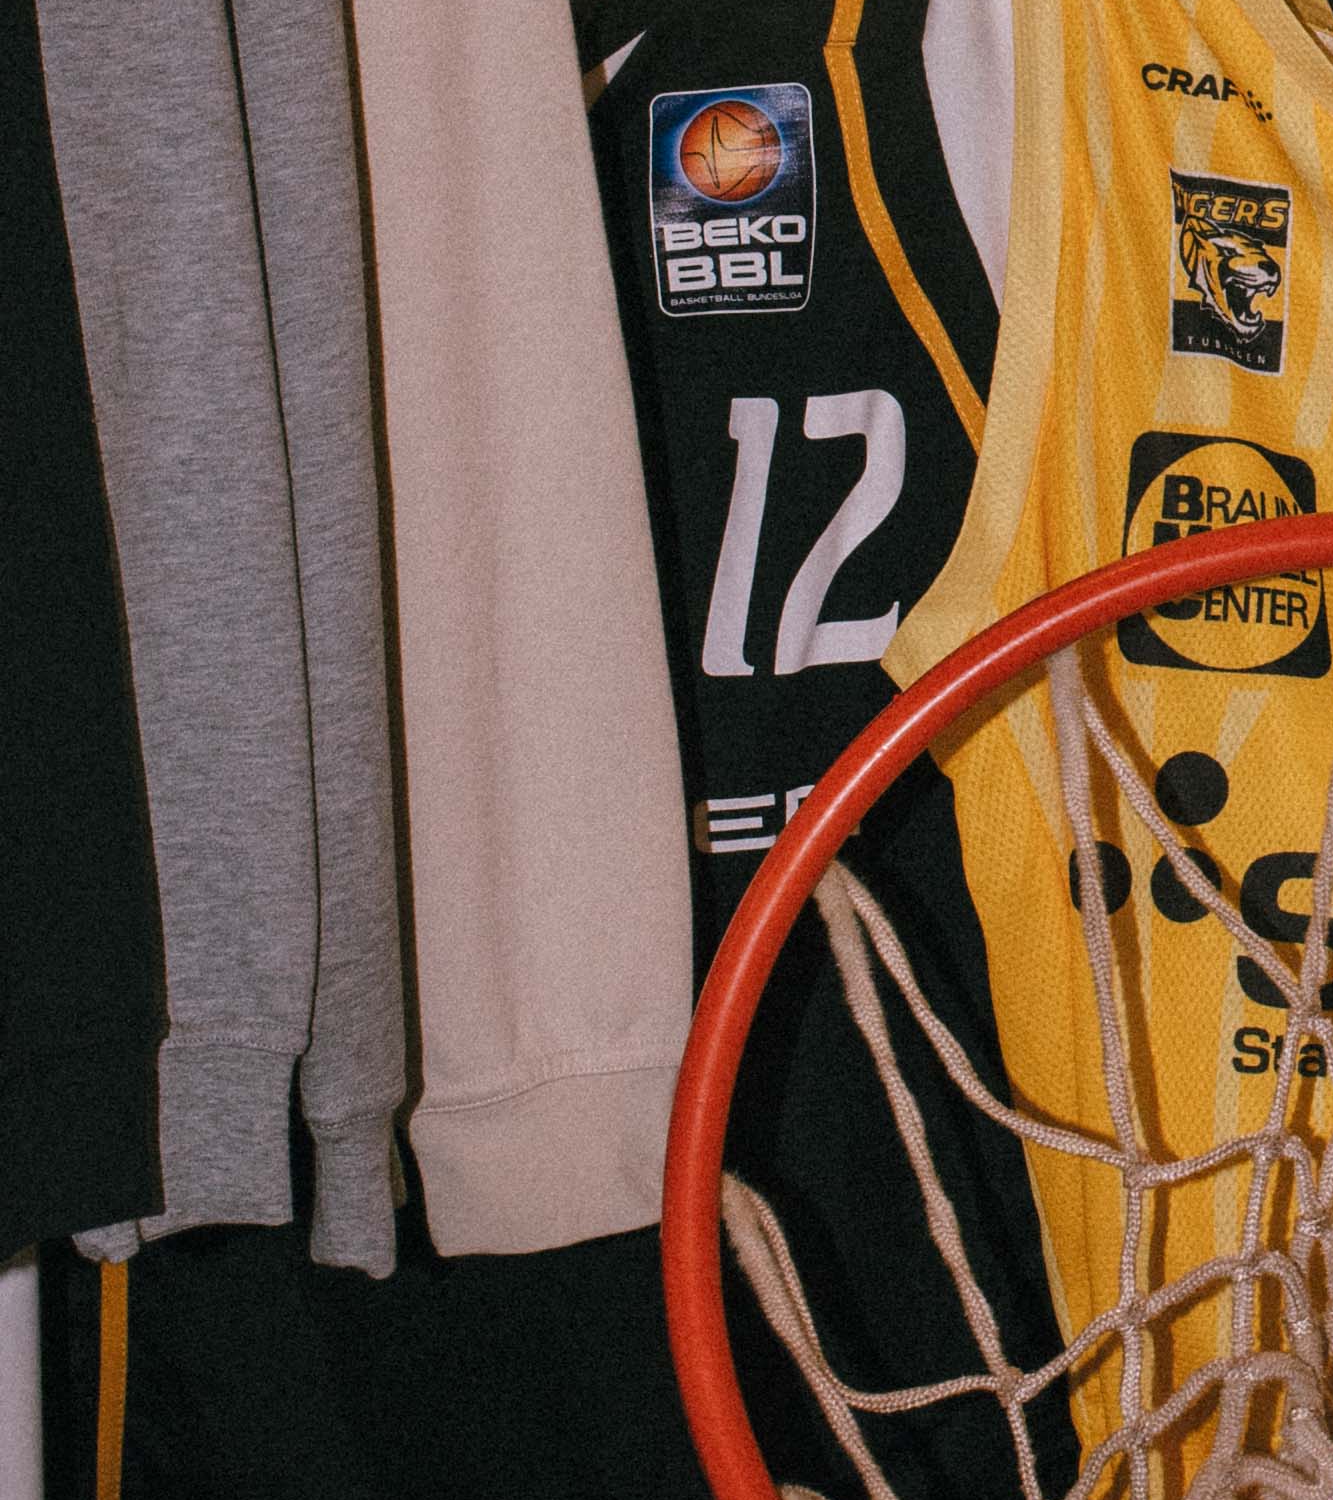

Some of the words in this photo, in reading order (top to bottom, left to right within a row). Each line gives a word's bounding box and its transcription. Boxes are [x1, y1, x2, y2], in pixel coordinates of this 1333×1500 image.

[1141, 62, 1243, 102] CRAF
[1173, 182, 1290, 230] TIGERS
[663, 214, 807, 251] BEKO
[666, 251, 804, 292] BBL
[670, 293, 744, 307] BASKETBALL
[747, 291, 803, 302] BUNDESLIGA
[702, 388, 907, 677] 12
